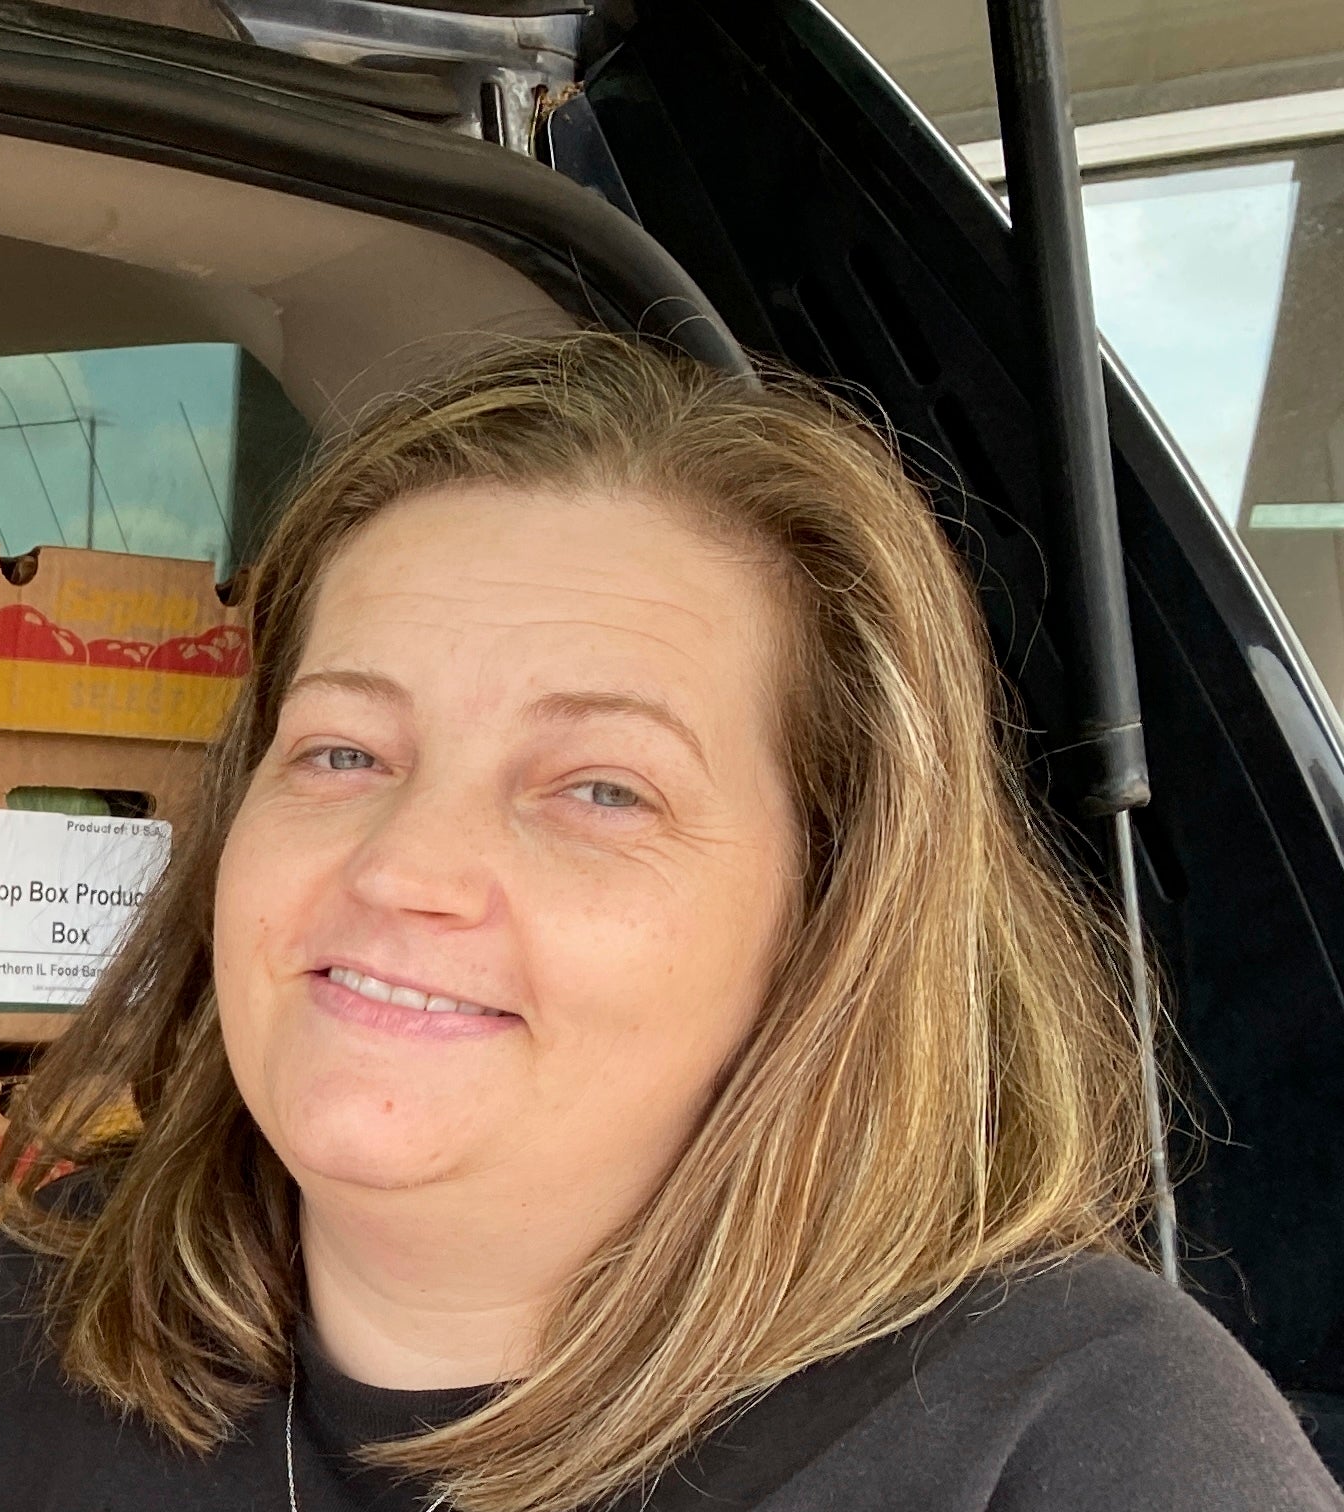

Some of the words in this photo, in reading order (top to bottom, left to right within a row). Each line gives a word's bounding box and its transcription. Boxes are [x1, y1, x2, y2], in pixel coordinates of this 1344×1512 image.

[67, 821, 112, 835] Product
[29, 881, 69, 905] Box
[76, 883, 146, 908] Produc
[52, 922, 91, 946] Box
[36, 965, 47, 977] IL
[50, 965, 79, 978] Food
